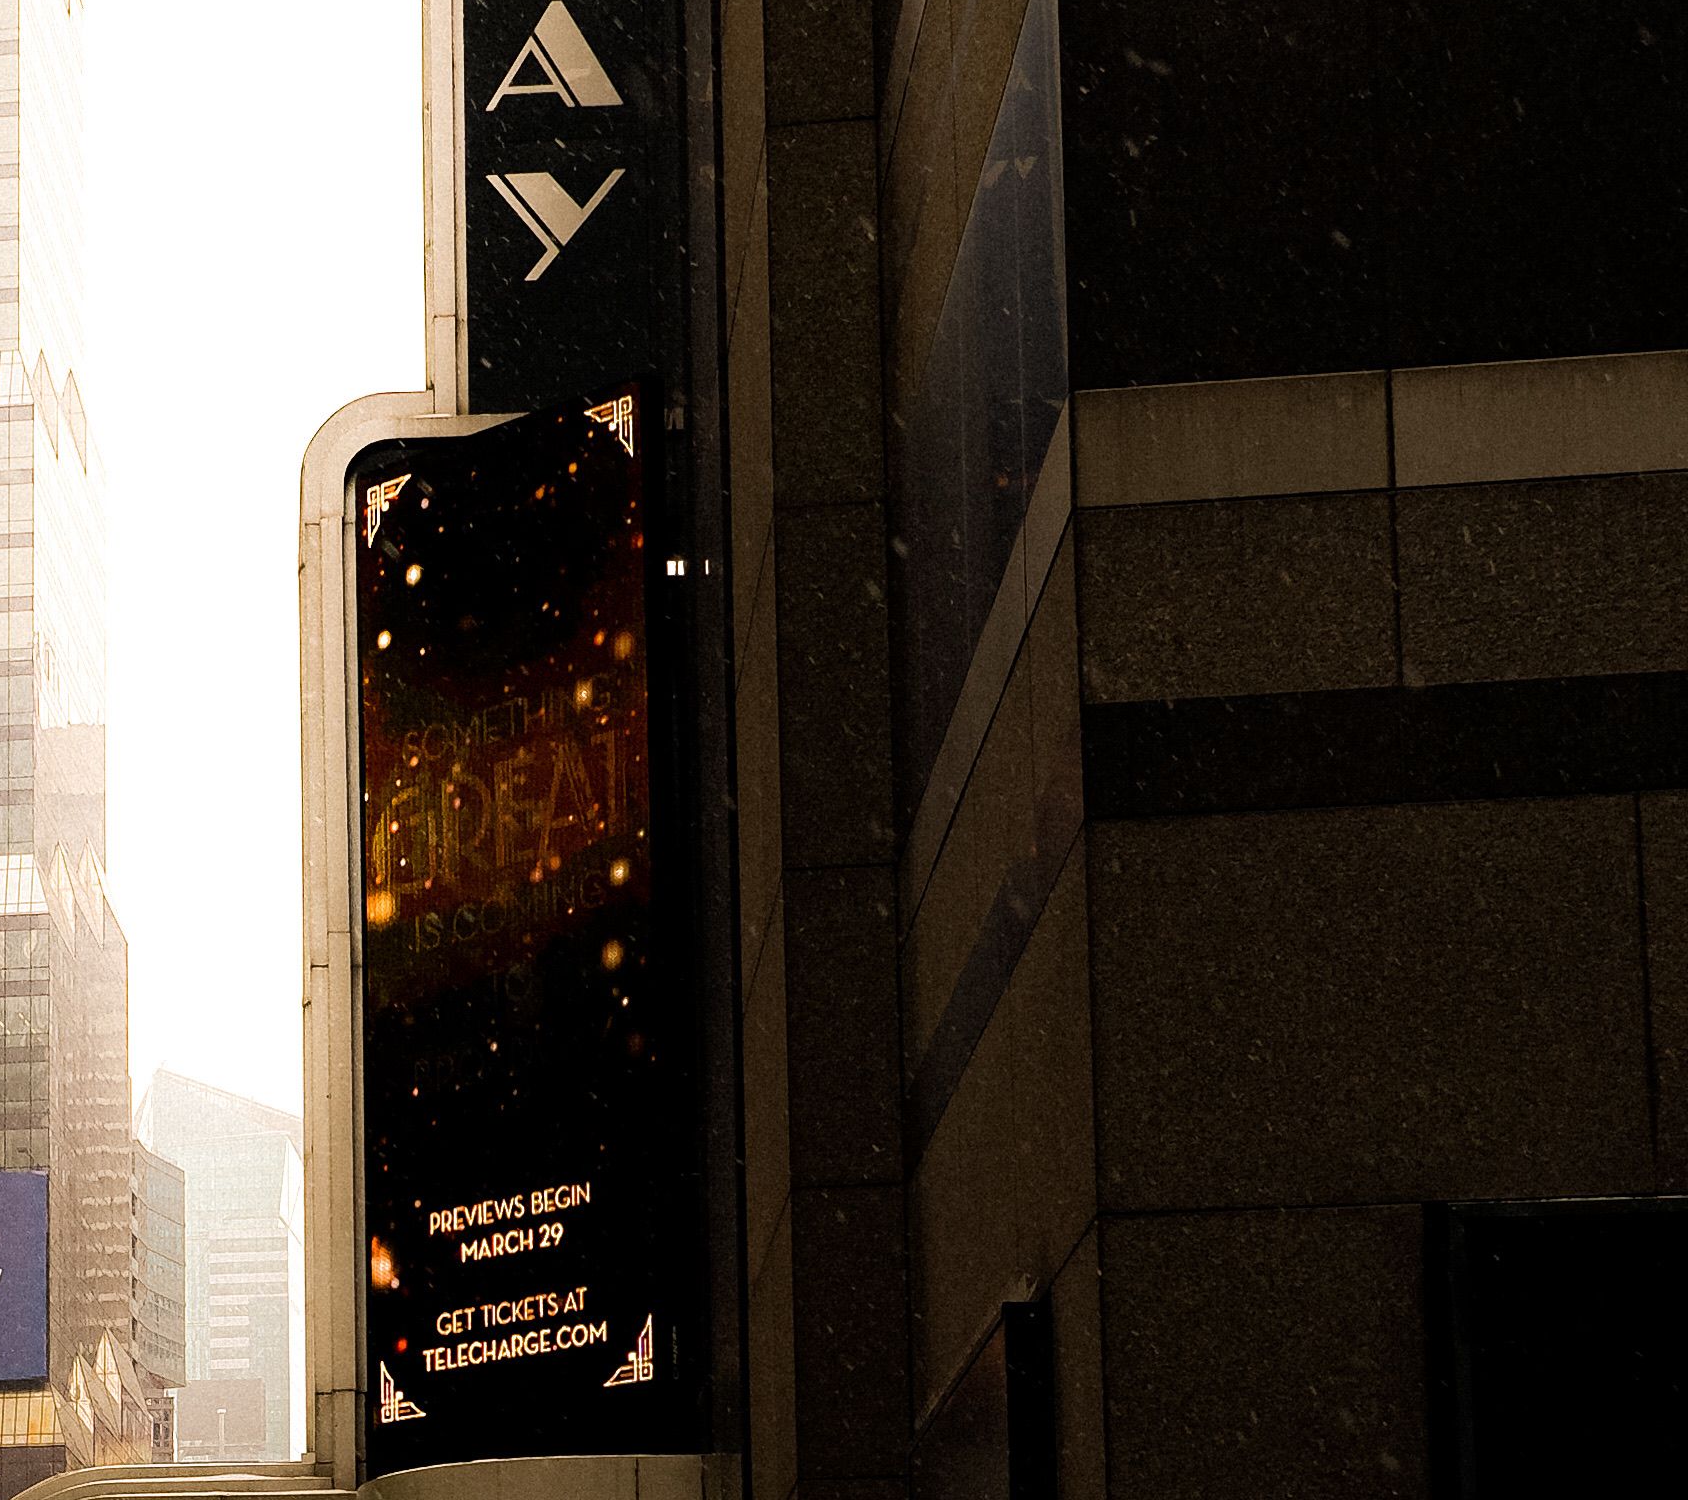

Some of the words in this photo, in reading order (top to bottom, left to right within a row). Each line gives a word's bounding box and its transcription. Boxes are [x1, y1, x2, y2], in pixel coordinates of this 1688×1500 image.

[428, 1192, 525, 1234] PREVIEWS
[532, 1183, 593, 1217] BEGIN
[460, 1230, 534, 1263] MARCH
[539, 1223, 565, 1251] 29
[435, 1307, 480, 1336] GET
[483, 1292, 558, 1330] TICKETS
[559, 1288, 588, 1314] AT
[421, 1319, 608, 1373] TELECHARGE.COM
